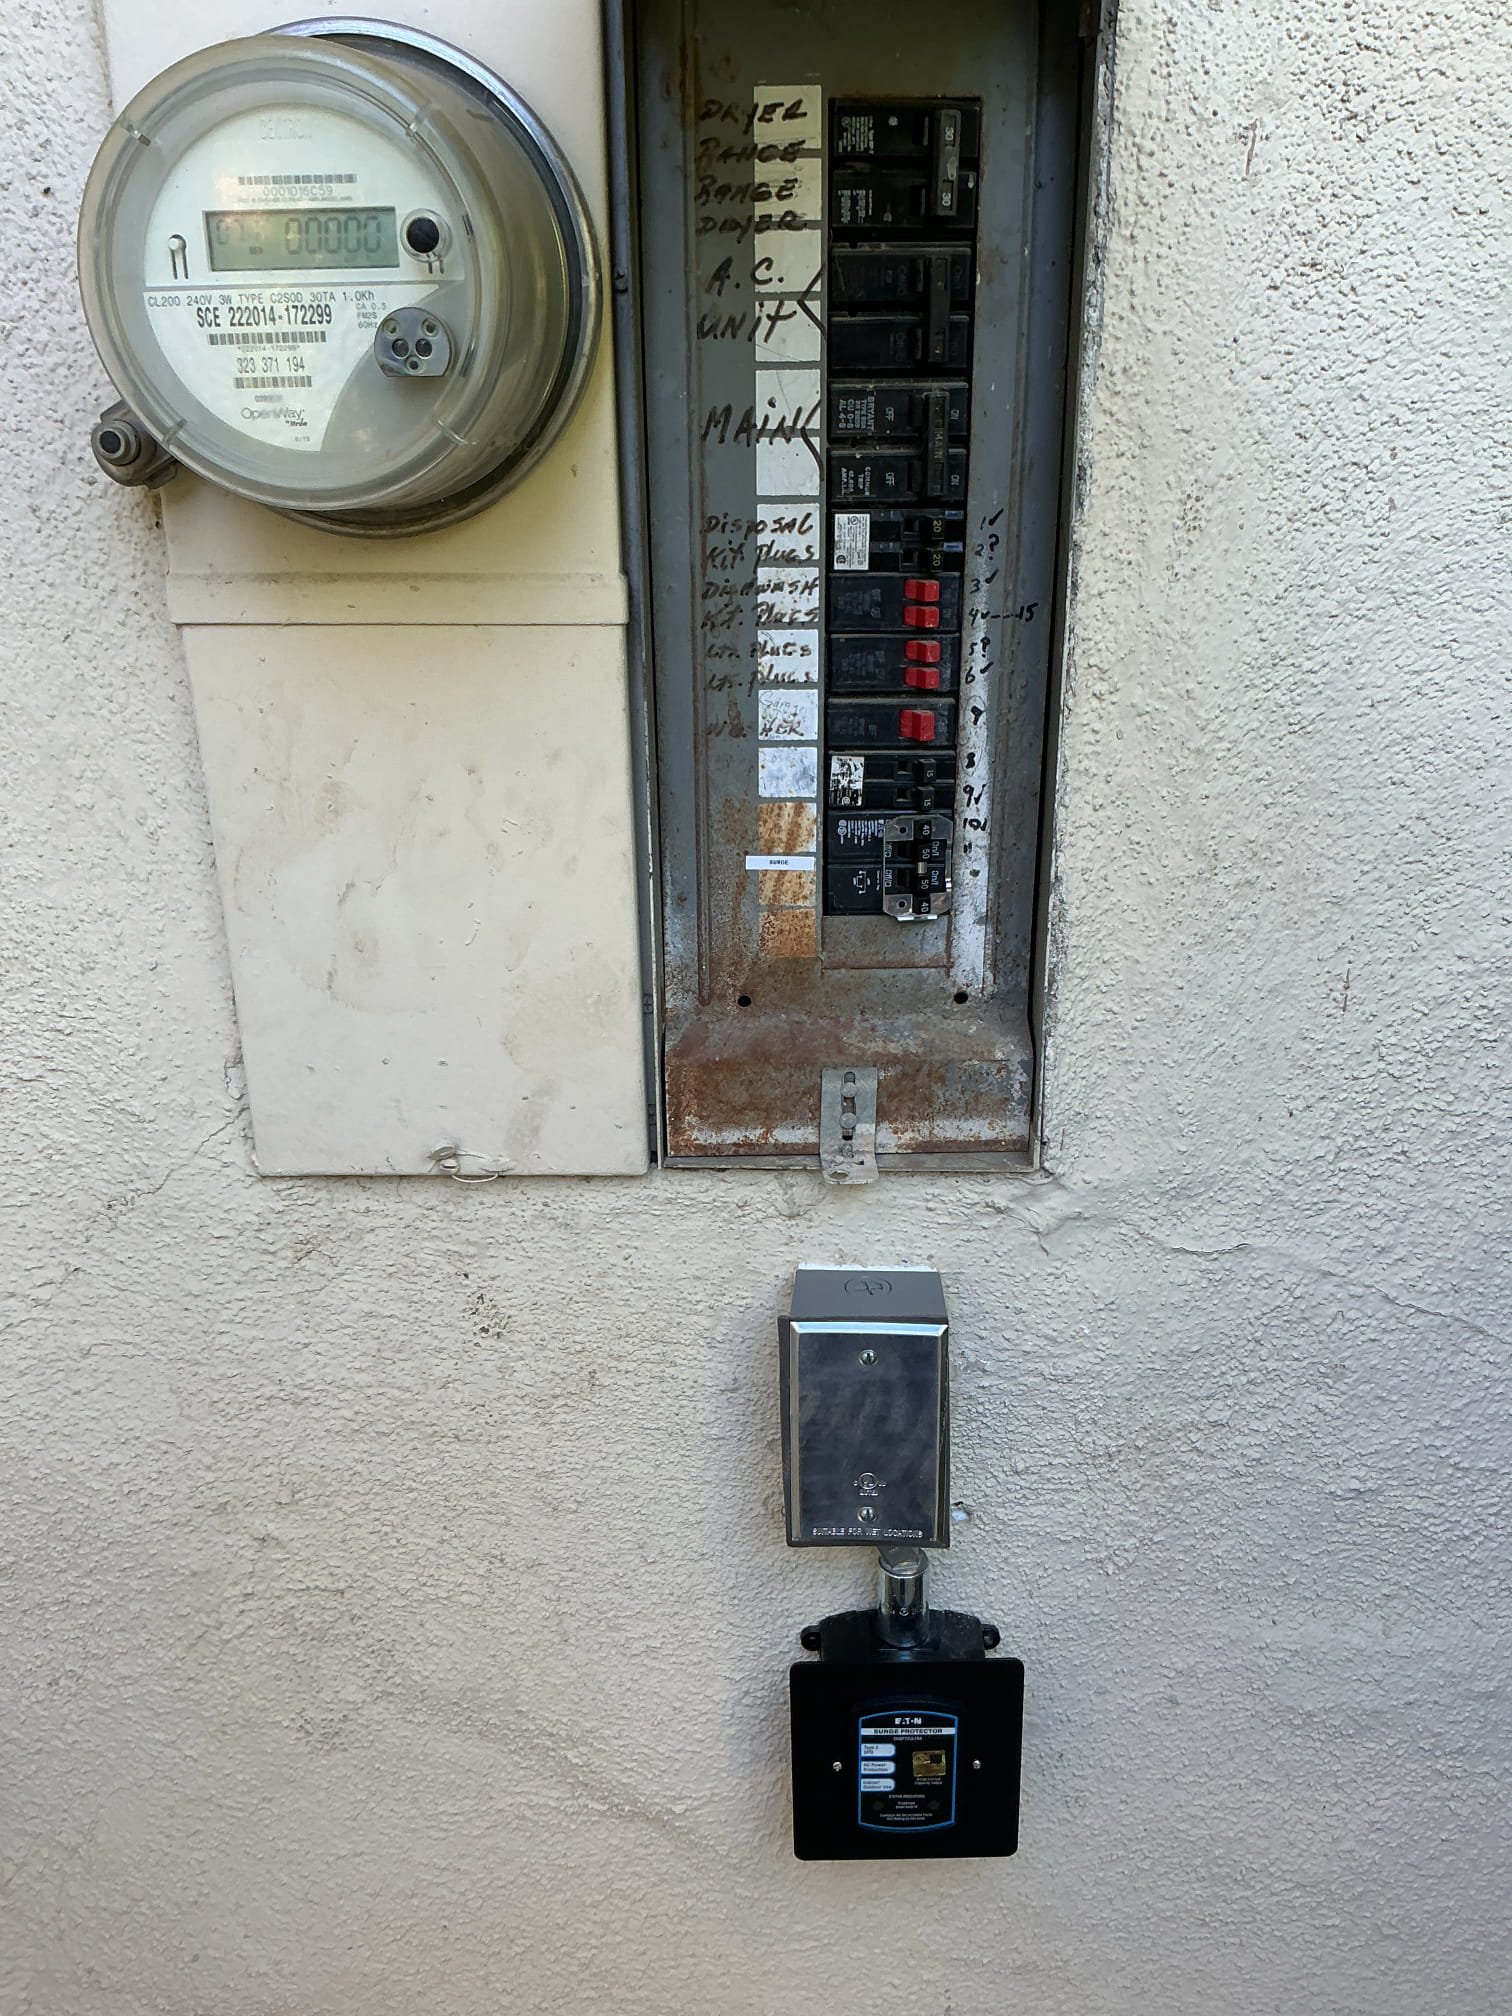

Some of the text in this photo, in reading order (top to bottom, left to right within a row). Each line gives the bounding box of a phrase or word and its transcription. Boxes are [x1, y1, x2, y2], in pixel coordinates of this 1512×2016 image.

[945, 127, 954, 141] 30
[942, 192, 951, 206] 30
[147, 295, 181, 308] CL200
[187, 294, 212, 307] 240V
[219, 294, 232, 305] 3W
[238, 293, 263, 304] TYPE
[309, 291, 336, 303] 30TA
[196, 303, 332, 329] SCE 222014-172299
[236, 355, 305, 374] 323 371 194
[885, 406, 894, 422] OFF
[950, 409, 960, 420] ON
[885, 472, 895, 487] OFF
[950, 474, 960, 485] ON
[932, 520, 942, 533] 20
[932, 553, 941, 566] 20
[970, 579, 981, 594] 3
[969, 608, 979, 626] 4
[965, 666, 975, 685] 6
[926, 770, 934, 778] 15
[963, 784, 974, 807] 9
[923, 799, 931, 807] 15
[922, 824, 930, 836] 40
[922, 848, 930, 860] 50
[921, 879, 929, 890] 50
[921, 901, 929, 912] 40
[812, 1527, 924, 1538] SUITABLE FOR WET LOCATIONS
